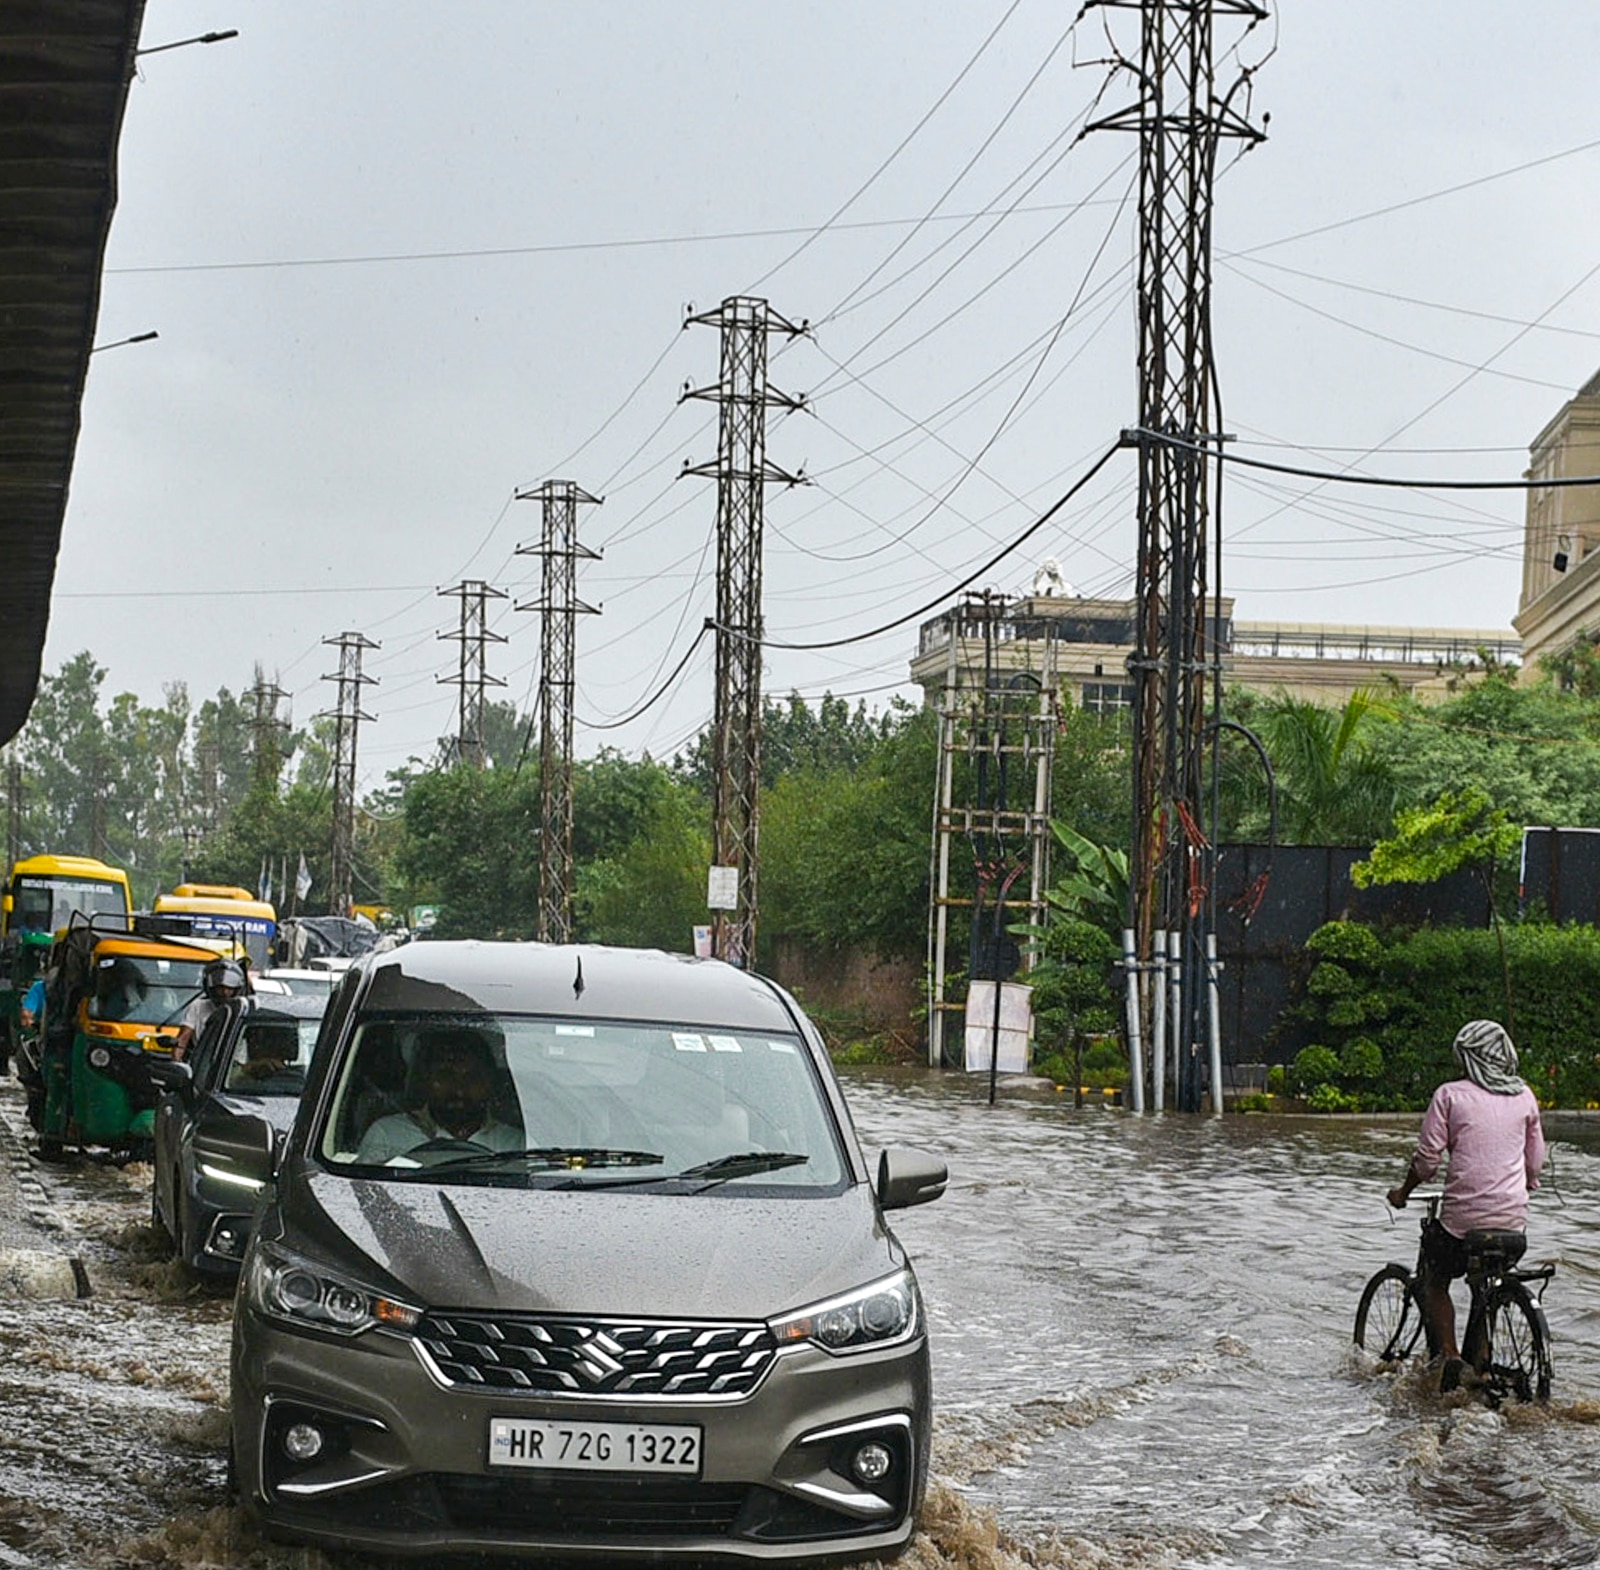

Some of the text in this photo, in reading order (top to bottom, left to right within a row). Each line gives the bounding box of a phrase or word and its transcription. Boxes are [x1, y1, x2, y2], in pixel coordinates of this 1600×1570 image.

[494, 1437, 510, 1447] IND
[510, 1429, 696, 1465] HR 72G 1322
